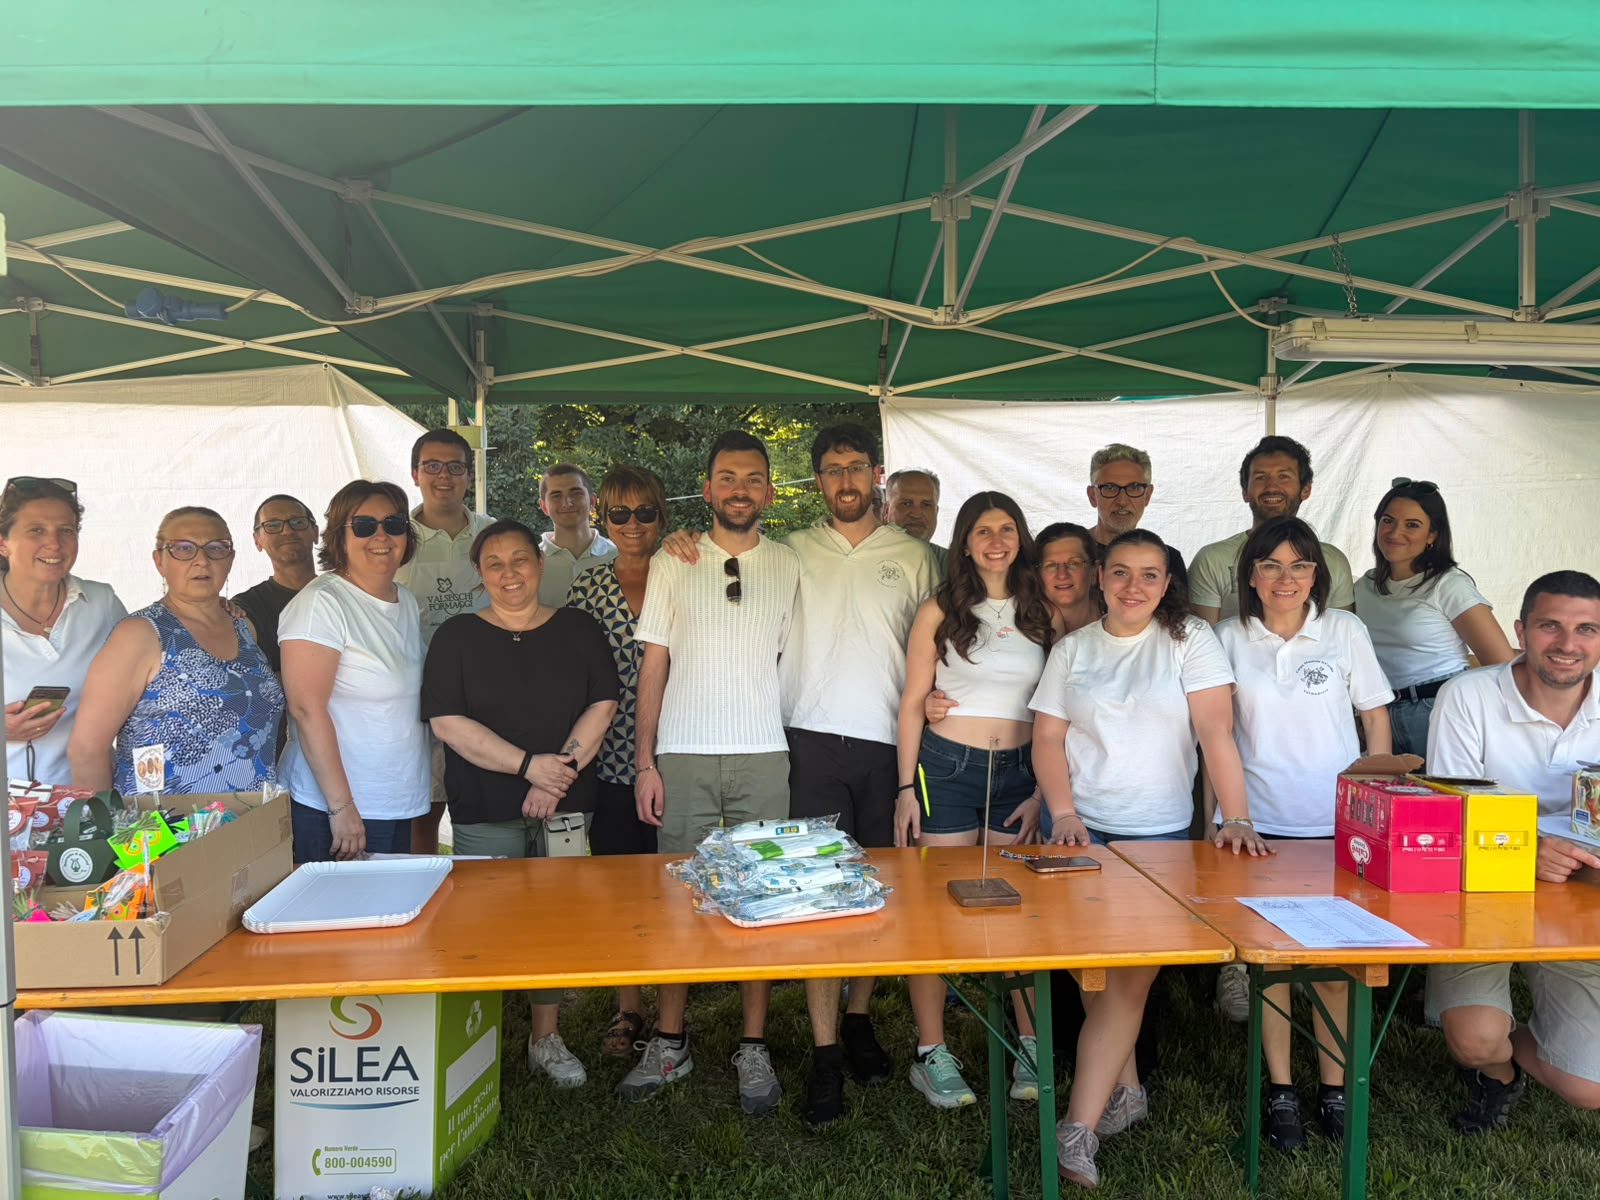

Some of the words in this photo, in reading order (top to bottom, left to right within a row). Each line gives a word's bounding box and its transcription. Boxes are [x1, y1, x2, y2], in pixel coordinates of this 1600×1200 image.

[427, 592, 473, 603] VALSECCHI
[429, 600, 473, 611] FORMAGGI
[290, 1045, 419, 1083] SiLEA
[290, 1087, 373, 1097] VALORIZZIAMO
[376, 1086, 420, 1096] RISORSE
[457, 1104, 472, 1125] tuo
[473, 1081, 494, 1113] gesto
[325, 1156, 392, 1168] 800-004590
[439, 1142, 456, 1171] per
